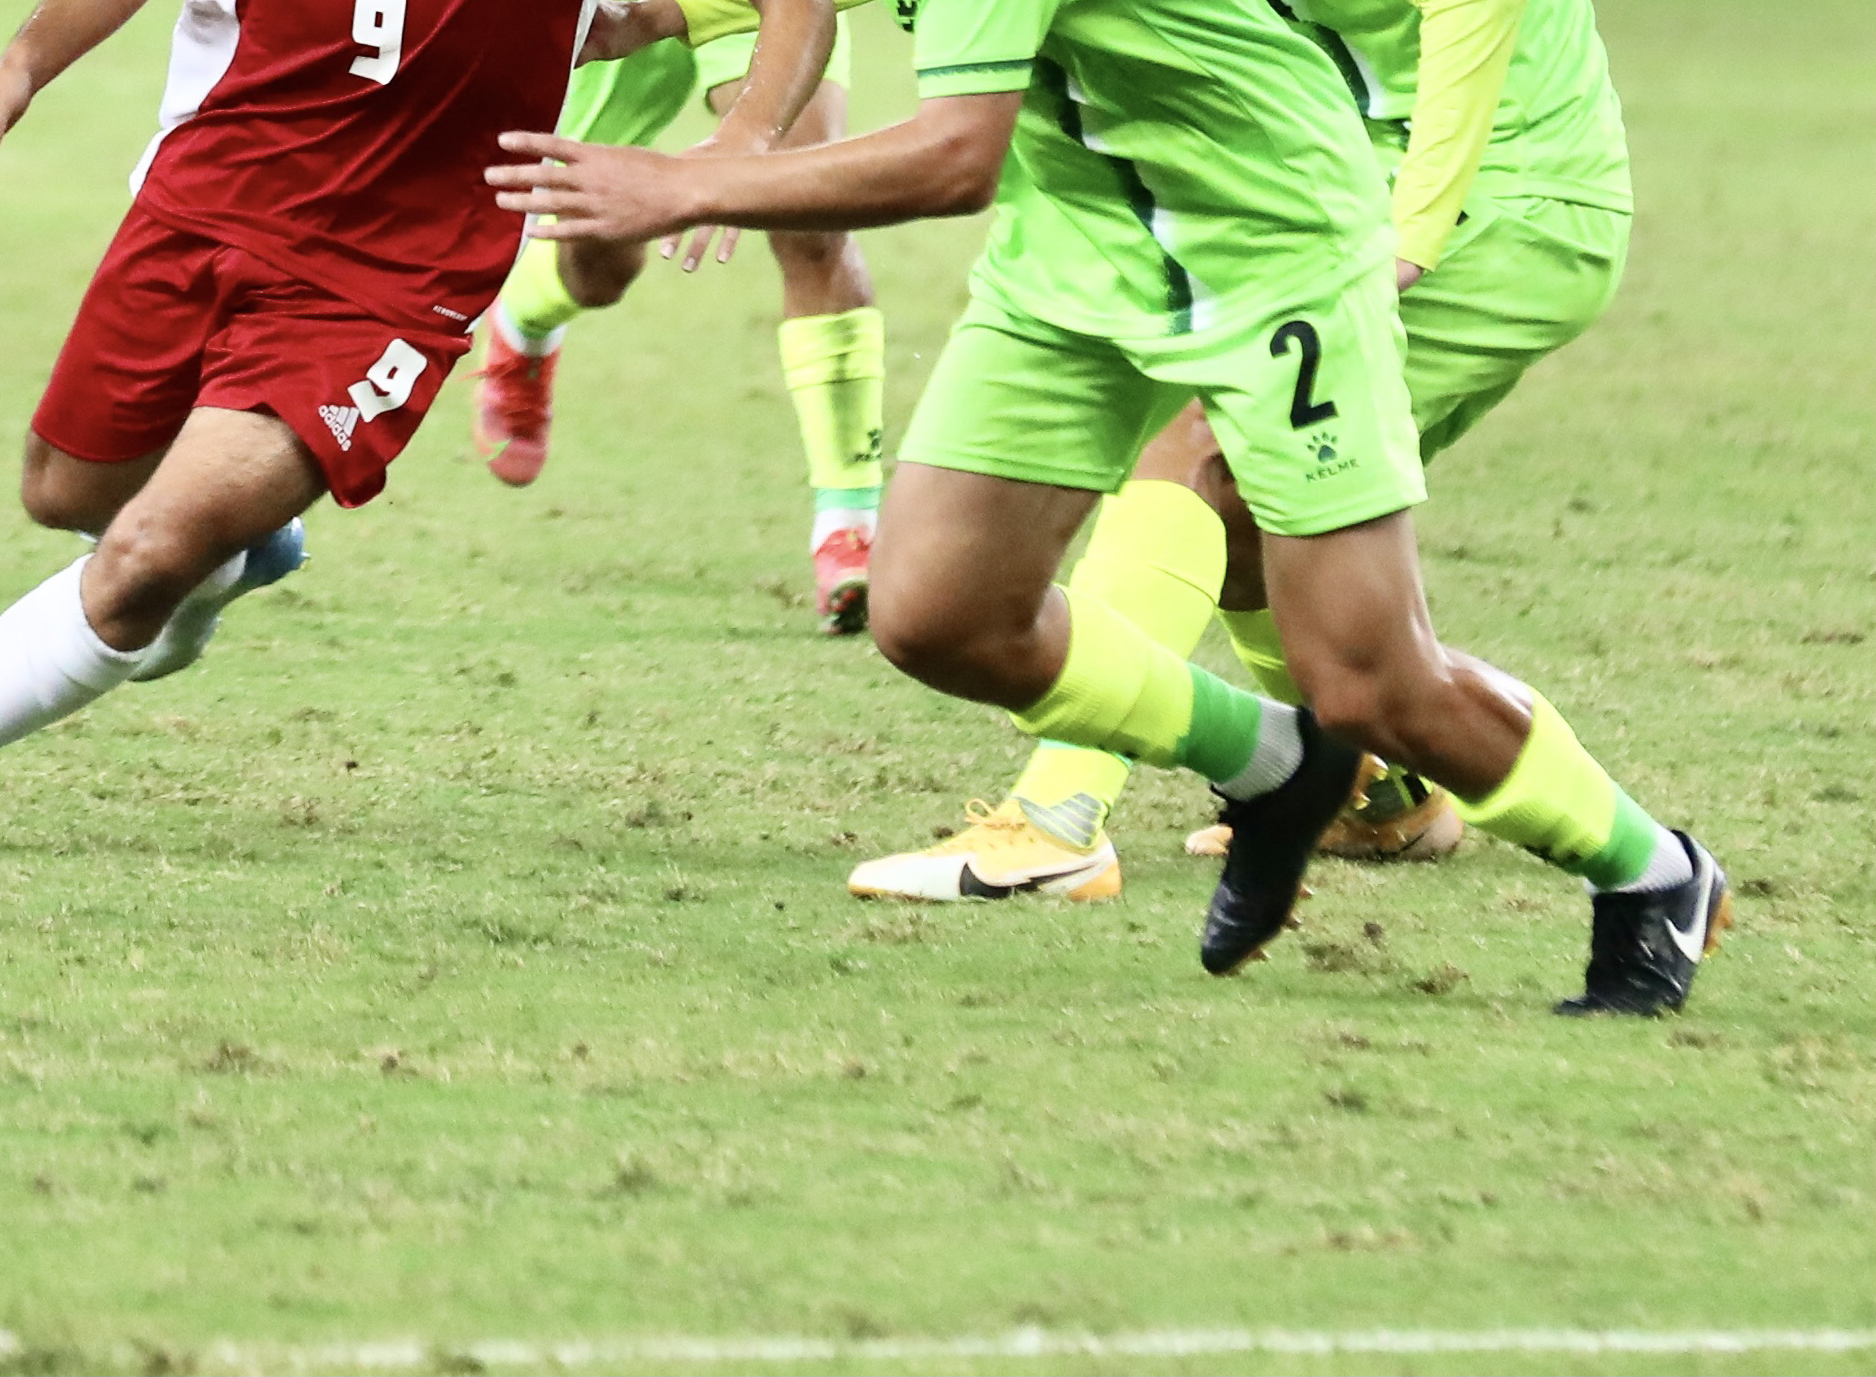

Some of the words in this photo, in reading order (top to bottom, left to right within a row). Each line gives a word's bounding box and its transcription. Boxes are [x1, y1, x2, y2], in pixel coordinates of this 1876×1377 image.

[347, 338, 428, 423] 9
[1270, 320, 1340, 430] 2
[318, 404, 352, 451] adidas
[1305, 458, 1360, 483] KELME
